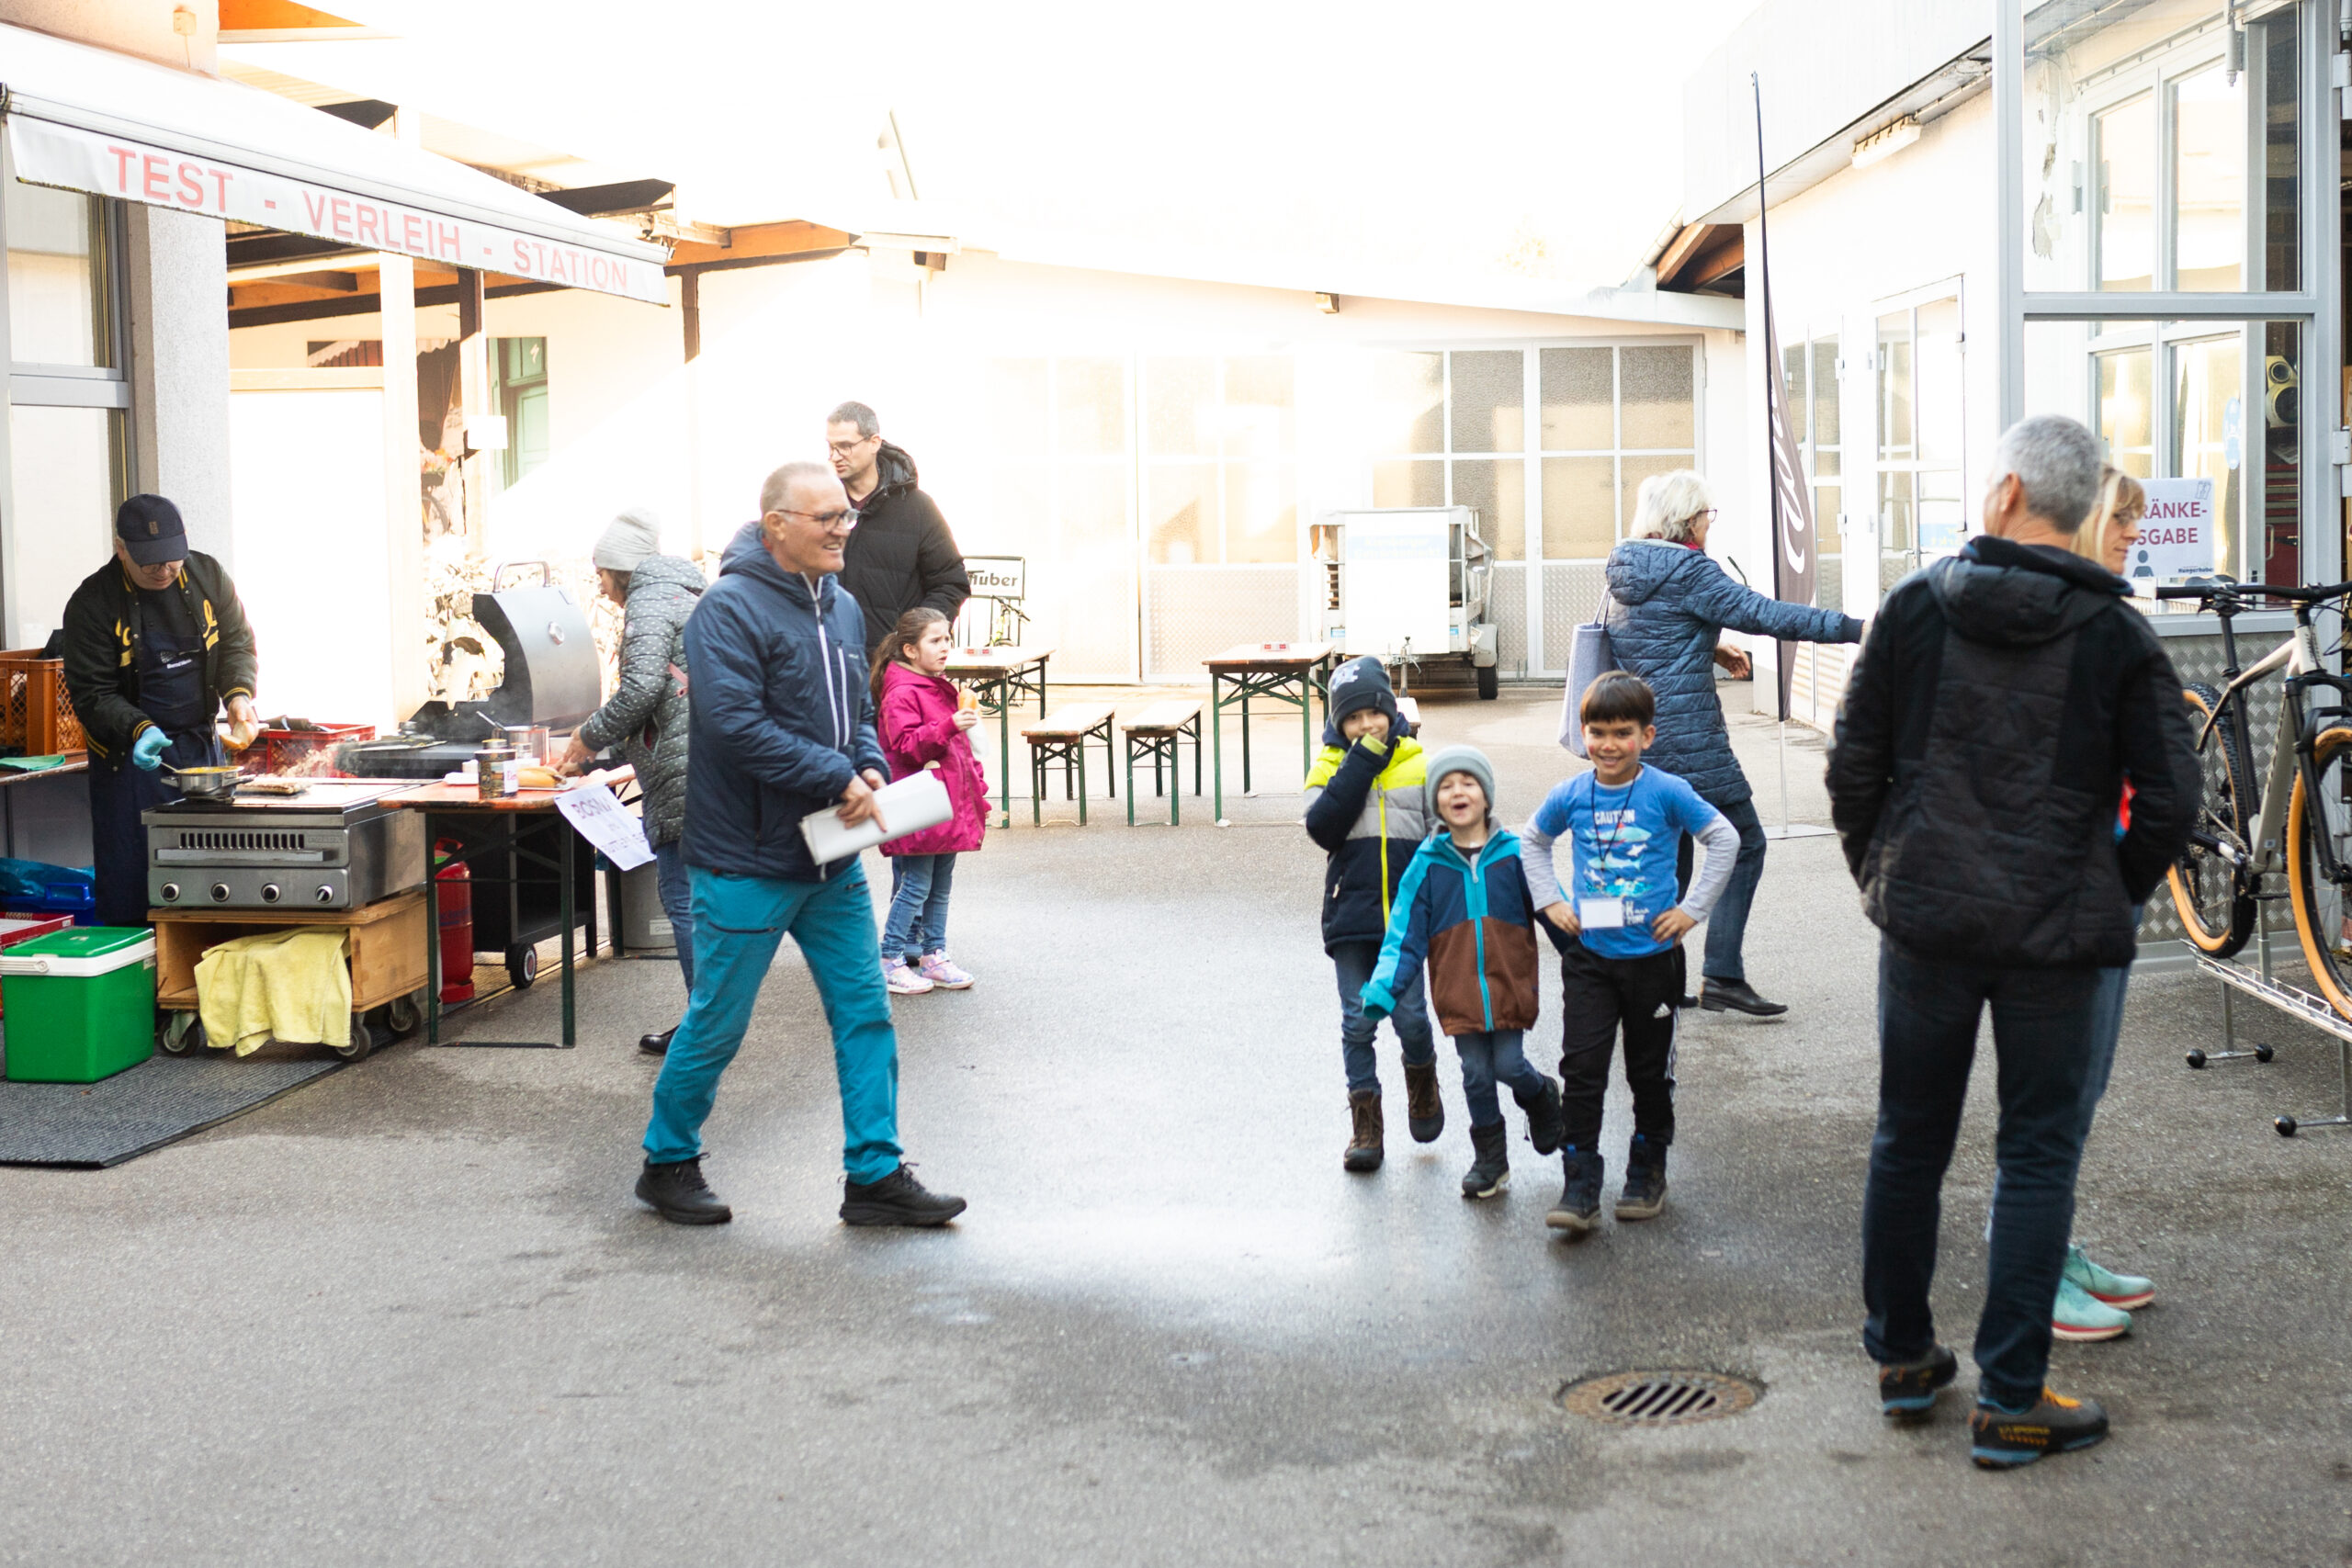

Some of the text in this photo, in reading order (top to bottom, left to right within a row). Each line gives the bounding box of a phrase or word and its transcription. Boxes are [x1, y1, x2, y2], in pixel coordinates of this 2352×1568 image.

[107, 144, 233, 212] TEST
[302, 190, 461, 261] VERLEIH
[513, 237, 628, 294] STATION
[2135, 527, 2199, 547] SGABE
[1594, 808, 1635, 826] CAUTON
